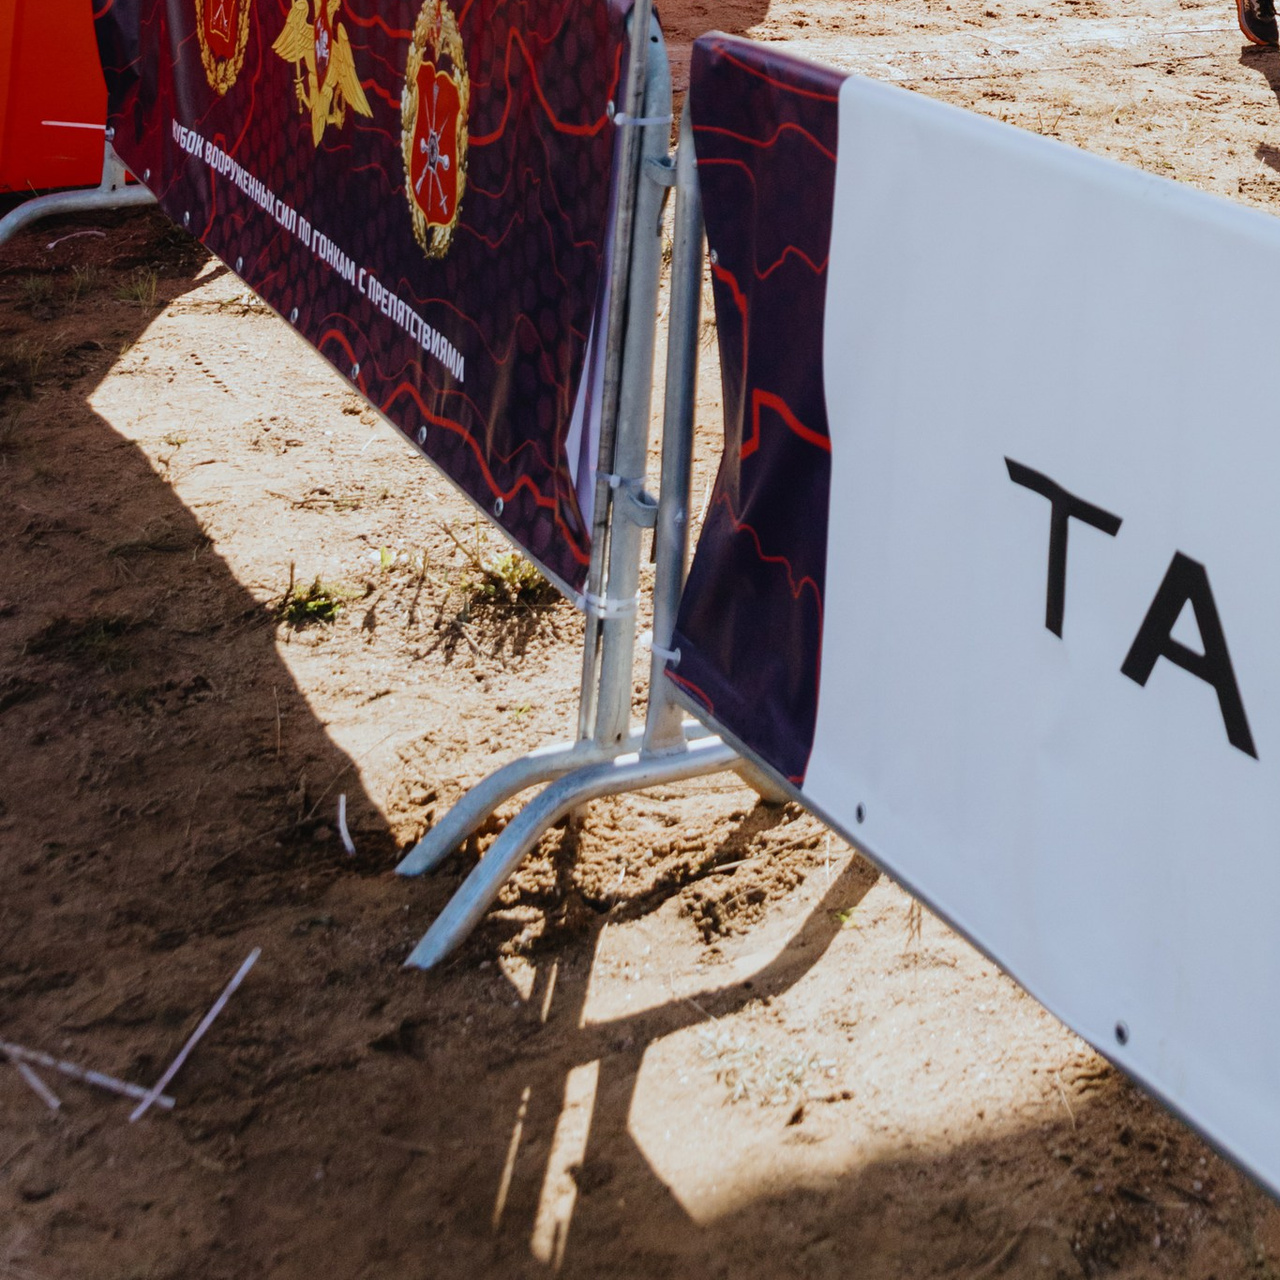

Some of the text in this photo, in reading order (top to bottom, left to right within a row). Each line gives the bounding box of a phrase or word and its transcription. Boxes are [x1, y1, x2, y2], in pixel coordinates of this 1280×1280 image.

[172, 117, 466, 384] КУБОК ВООРУЖЕННЫХ СИЛ ПО ГОНКАМ С ПРЕПЯТСТВИЯМИ
